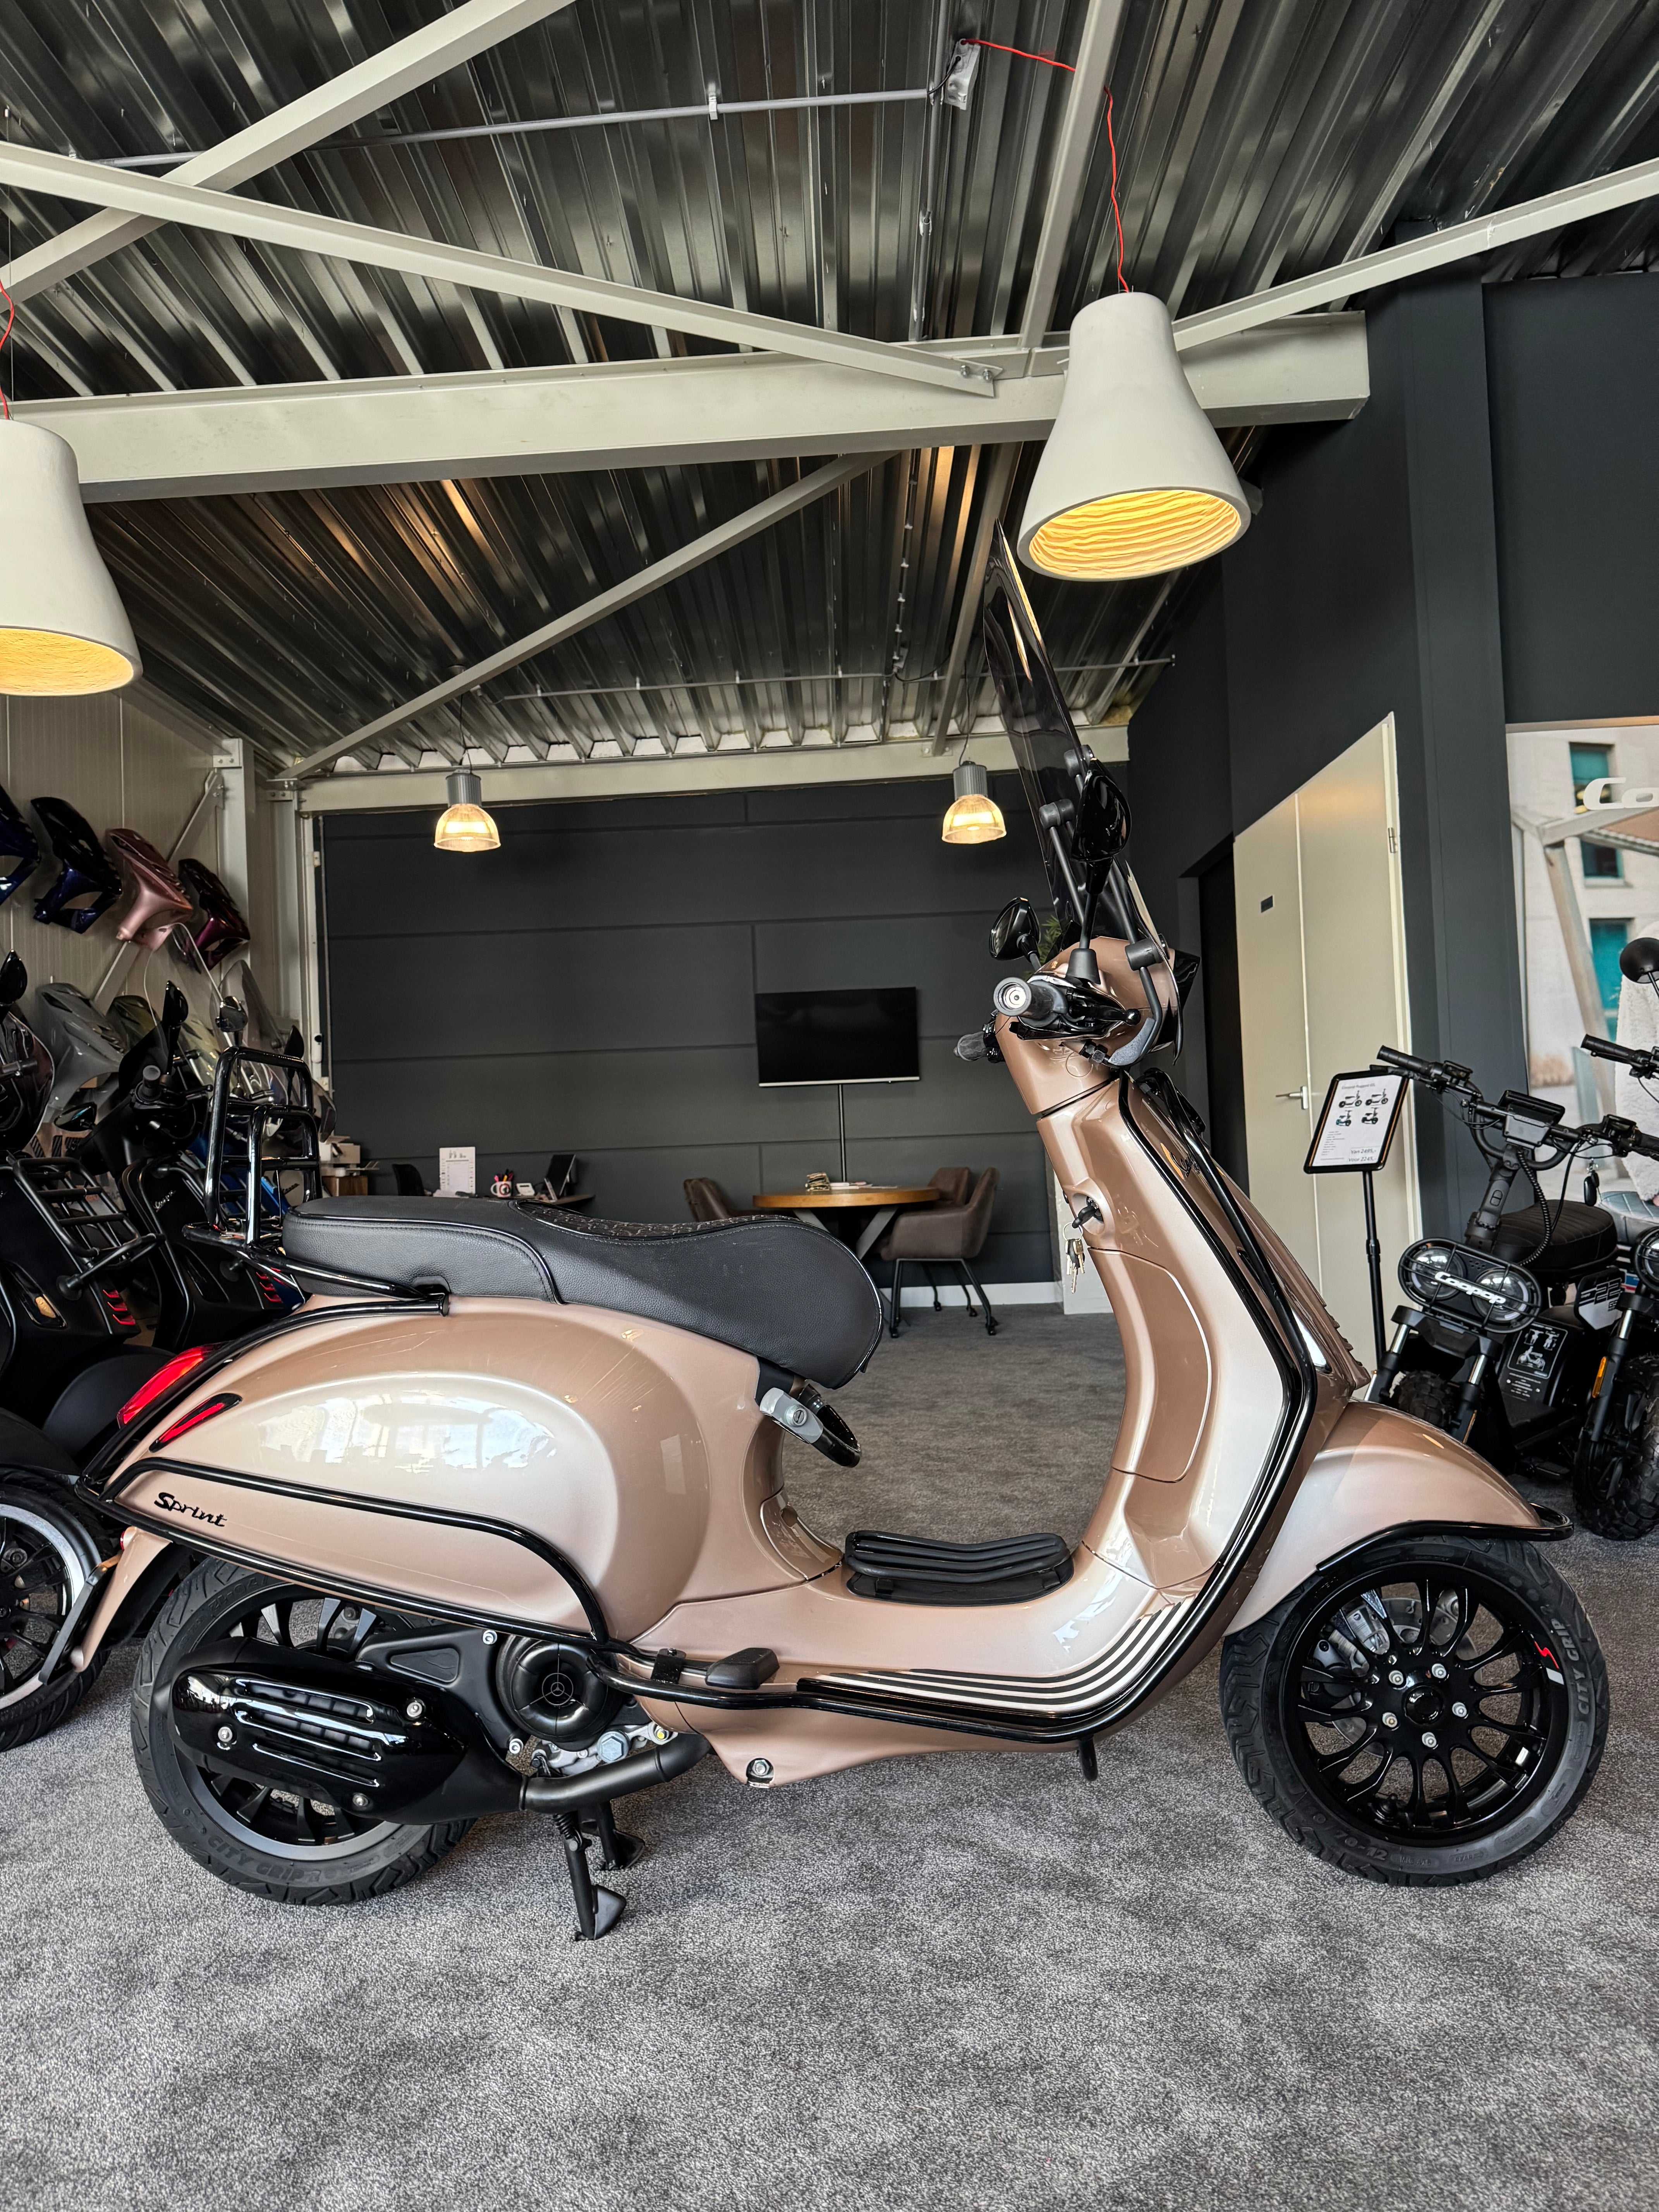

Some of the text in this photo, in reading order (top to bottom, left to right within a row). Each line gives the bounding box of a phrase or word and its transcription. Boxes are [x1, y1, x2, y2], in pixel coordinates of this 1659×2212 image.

[1434, 1271, 1506, 1304] Coopop
[154, 1492, 227, 1527] Sprint
[1551, 1618, 1580, 1661] GRIP
[1573, 1667, 1589, 1715] CITY
[208, 1835, 255, 1867] CITY
[256, 1862, 305, 1881] GRIP
